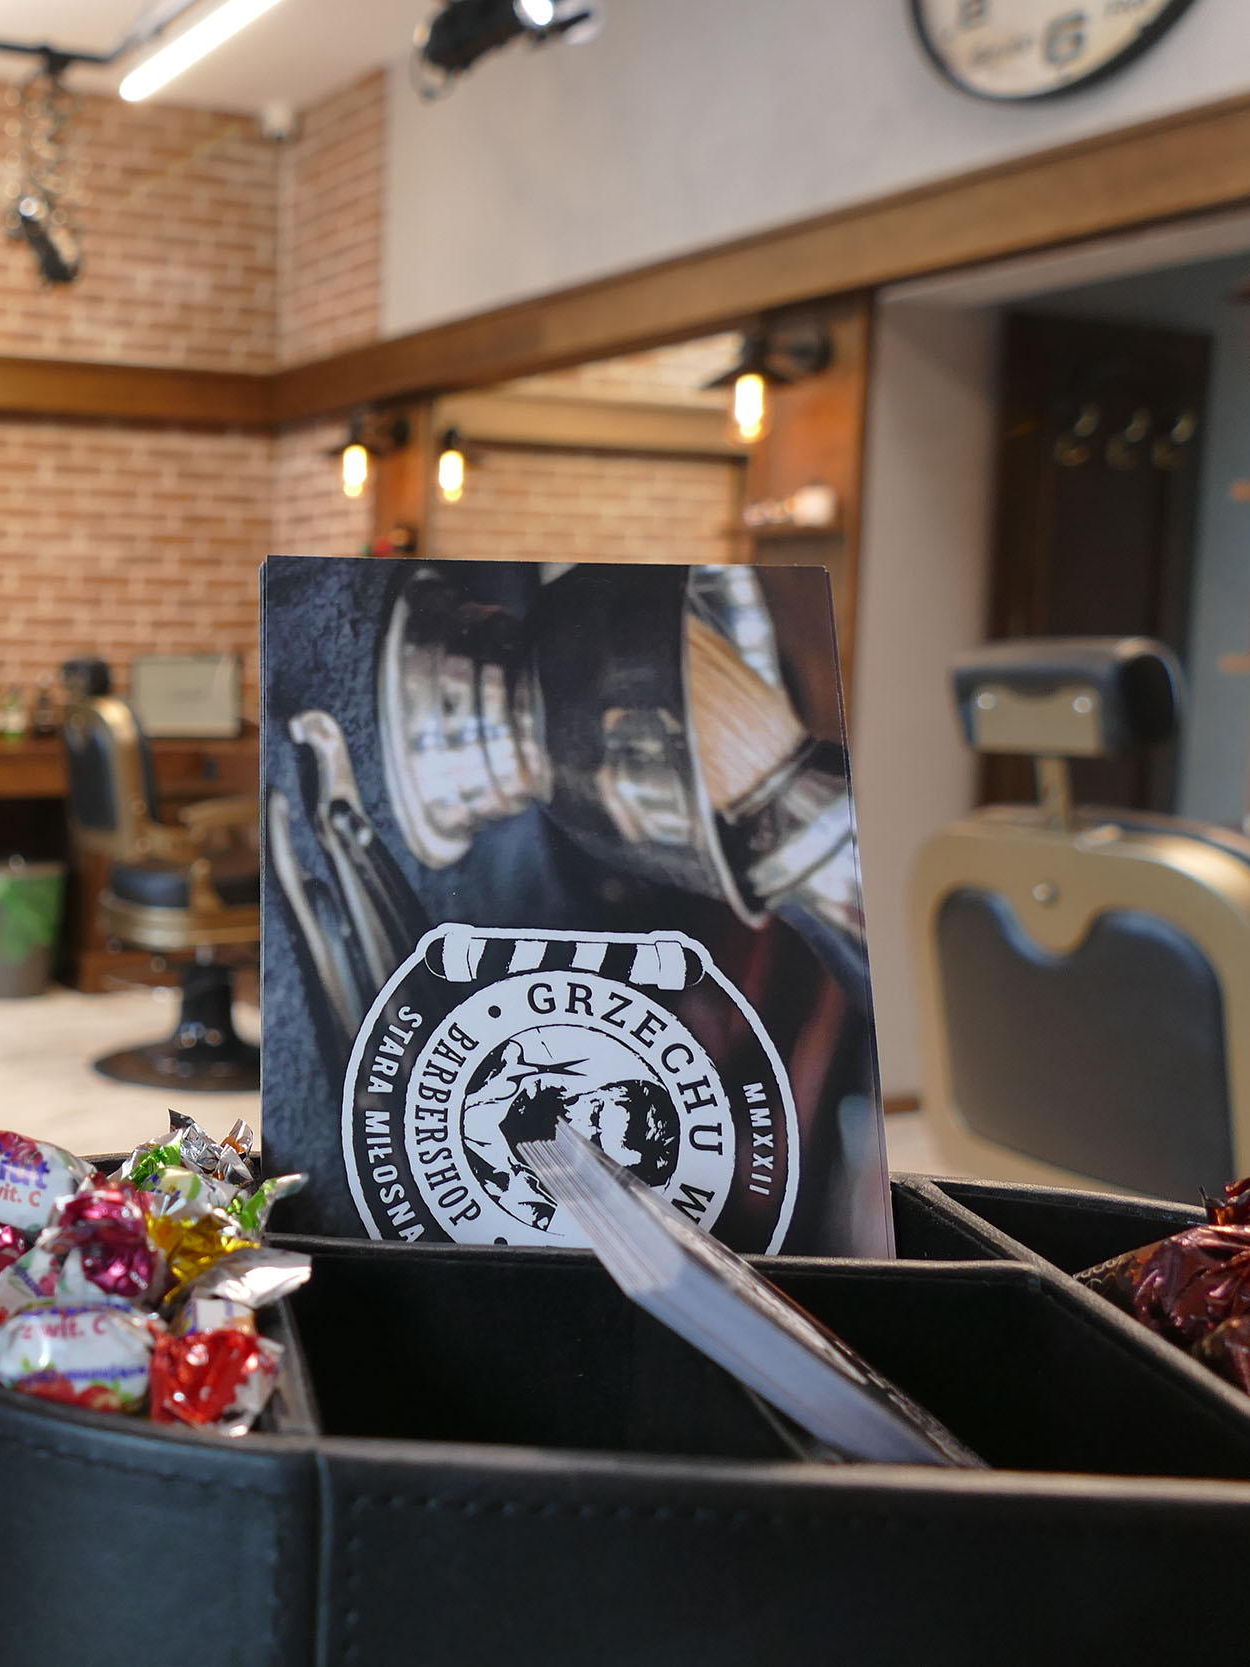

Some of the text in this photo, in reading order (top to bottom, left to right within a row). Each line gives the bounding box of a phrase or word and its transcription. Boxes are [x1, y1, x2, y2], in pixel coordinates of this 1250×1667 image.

[365, 1005, 425, 1243] STARA MIŁOSNA
[414, 1022, 481, 1227] BARBERSHOP
[527, 982, 723, 1156] GRZECHU
[742, 1082, 775, 1196] MMXXII
[28, 1190, 42, 1207] C
